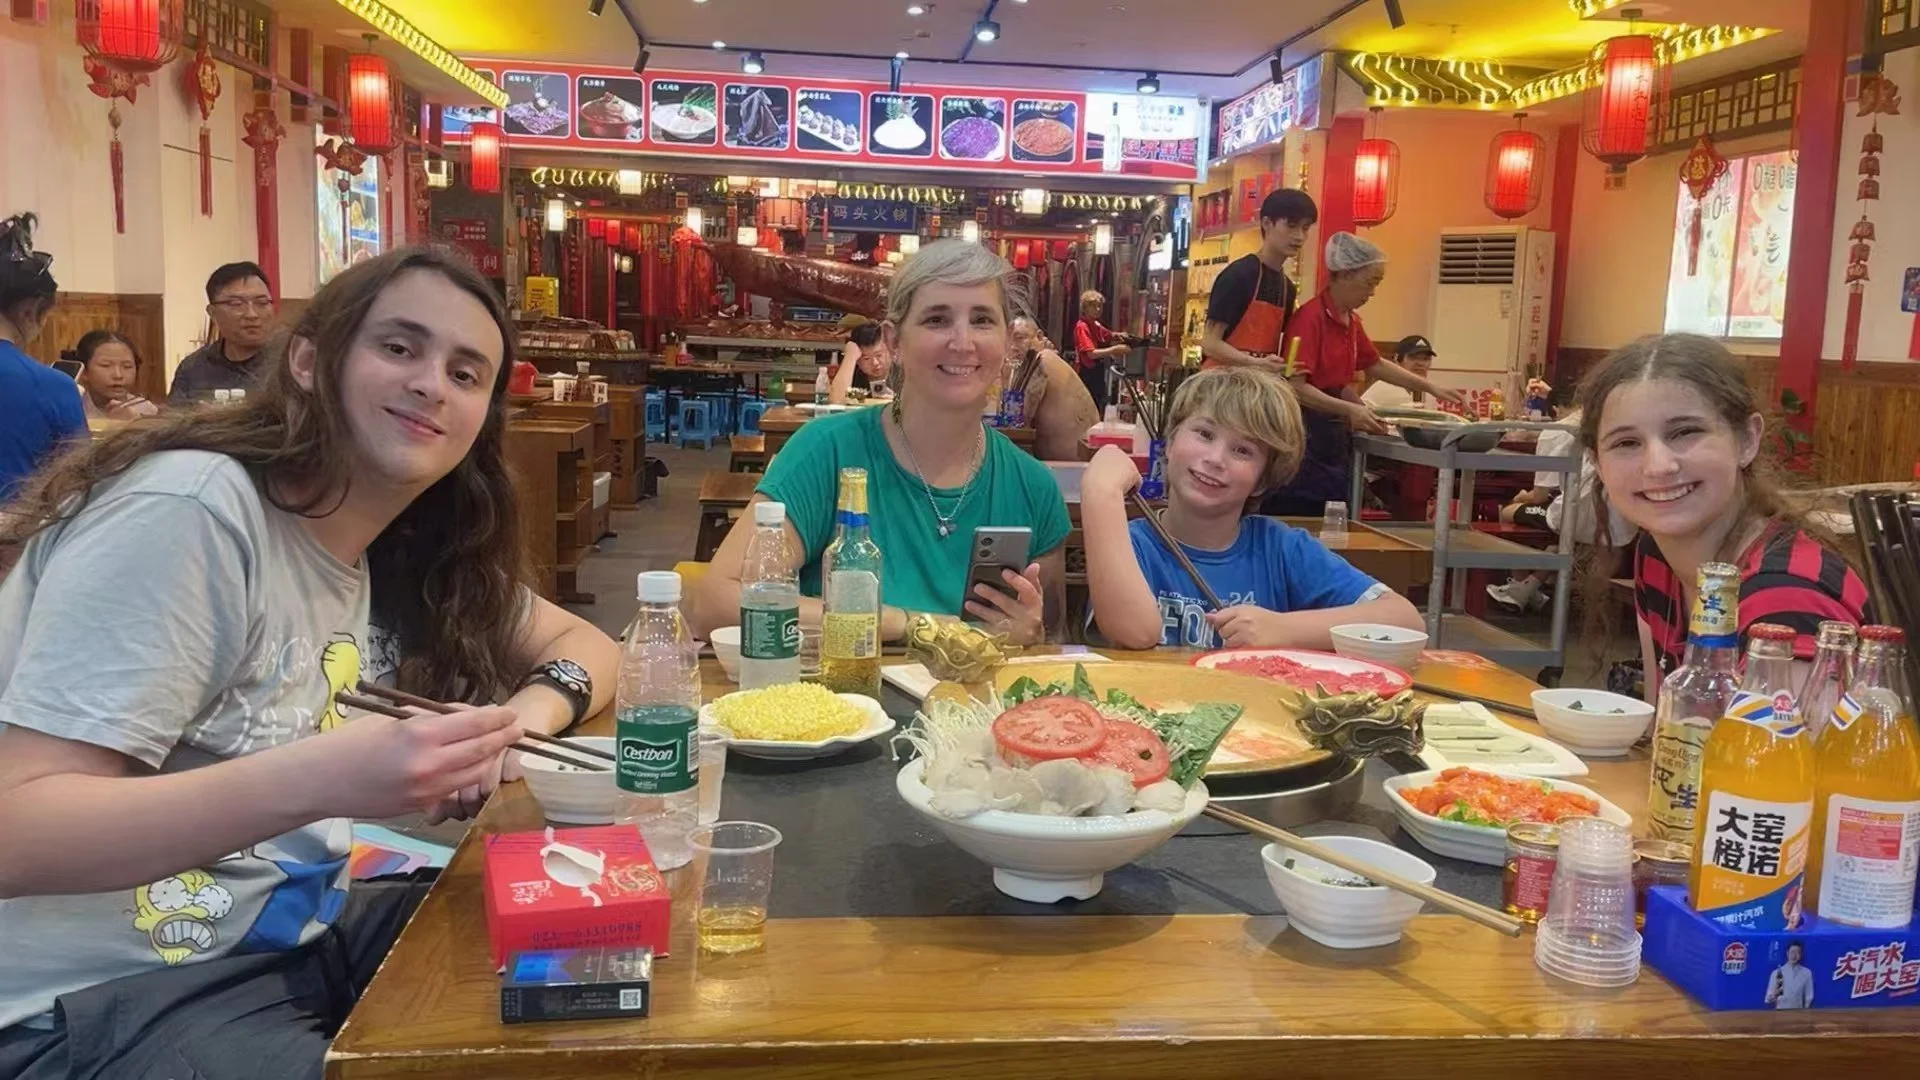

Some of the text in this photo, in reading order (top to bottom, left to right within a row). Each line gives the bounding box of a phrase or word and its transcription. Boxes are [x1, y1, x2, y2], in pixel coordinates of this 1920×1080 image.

[832, 204, 908, 222] 码头火锅
[623, 745, 674, 761] Cestbon
[1716, 806, 1786, 845] 大窑
[1712, 836, 1780, 876] 橙诺
[1836, 944, 1902, 976] 大汽水
[1854, 963, 1920, 995] 喝大窑
